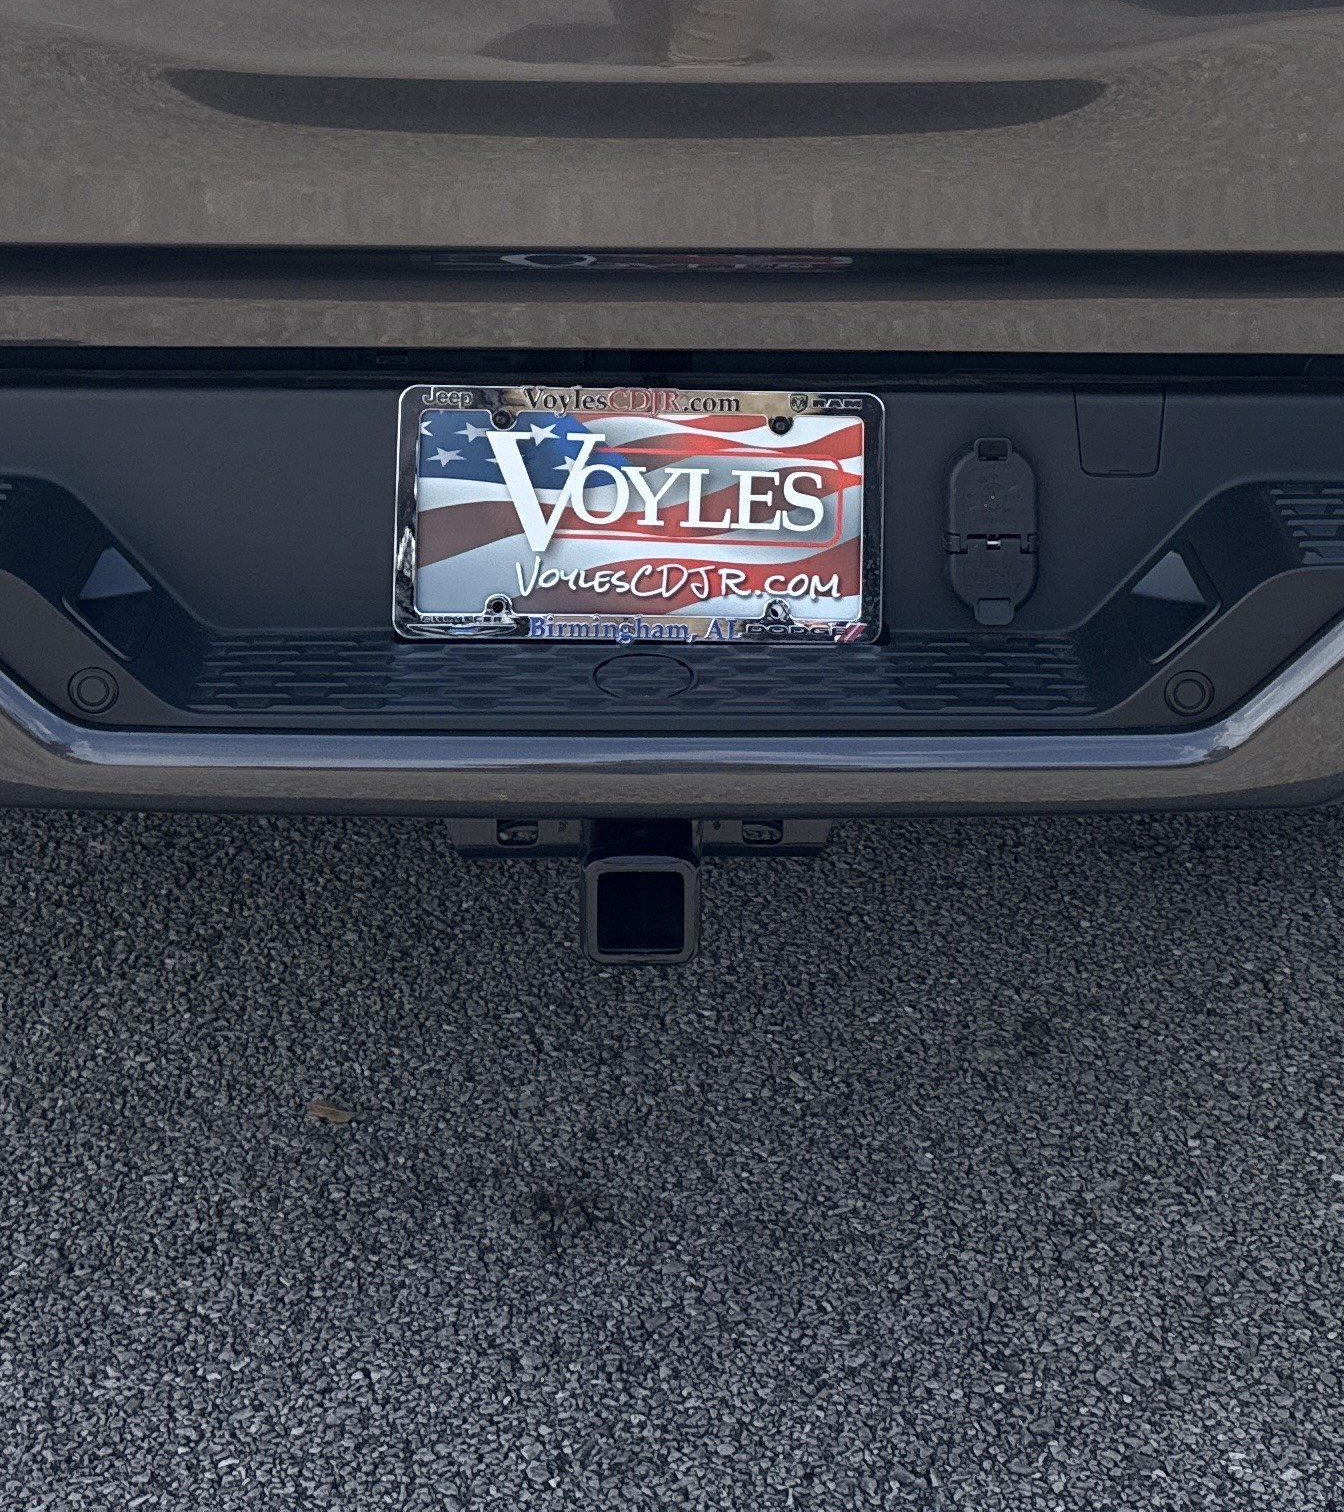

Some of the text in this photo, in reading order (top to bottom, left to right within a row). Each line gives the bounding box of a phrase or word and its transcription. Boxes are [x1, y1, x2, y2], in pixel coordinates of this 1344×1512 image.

[422, 386, 473, 408] Jeep
[523, 386, 741, 416] VoylesCDJR.com
[810, 398, 863, 409] RAM
[486, 431, 825, 551] VOYLES
[526, 615, 742, 646] Birmingham, AL
